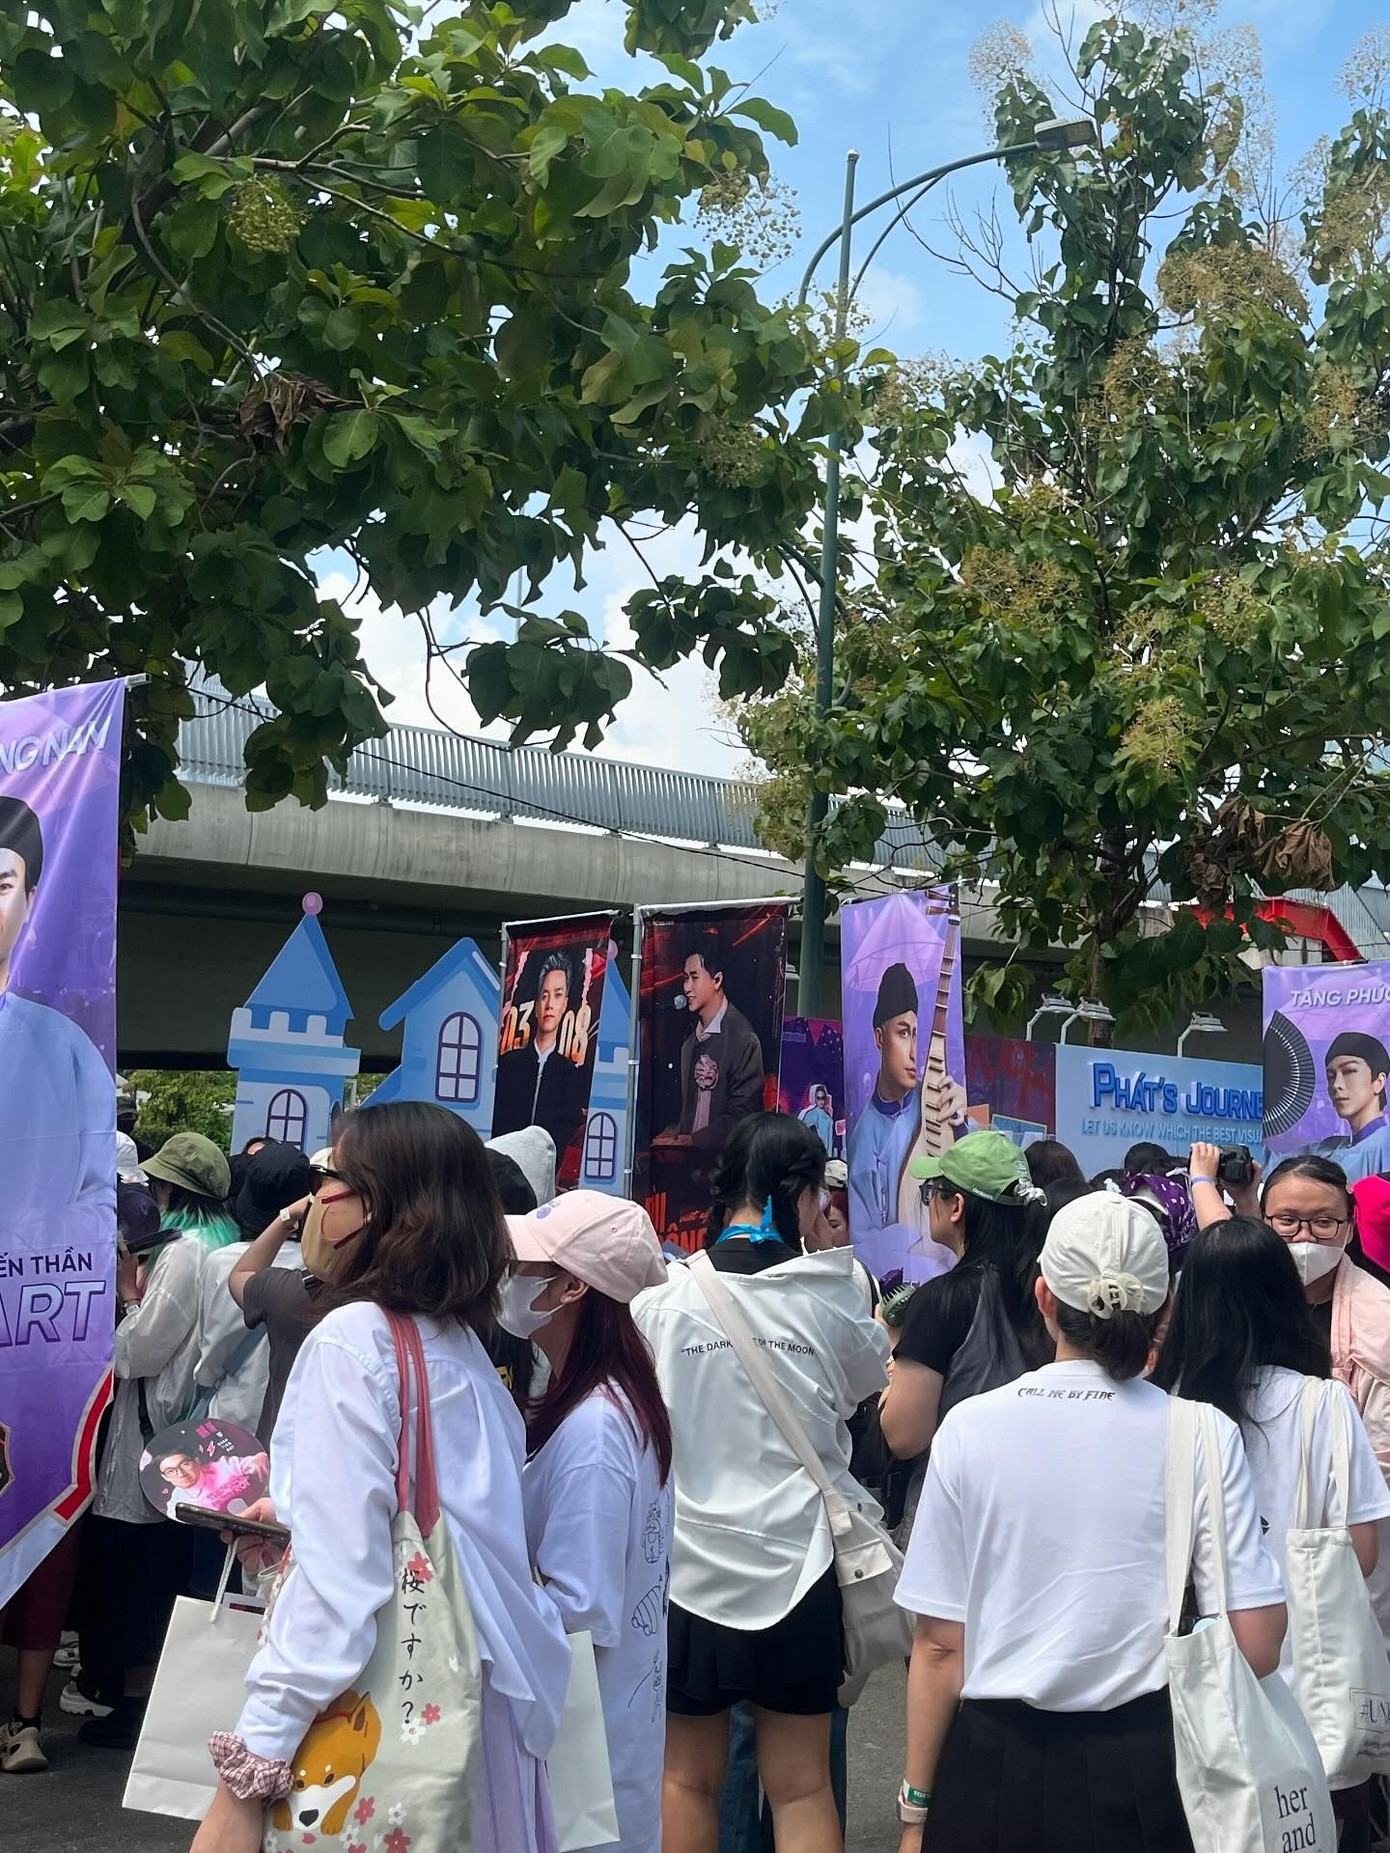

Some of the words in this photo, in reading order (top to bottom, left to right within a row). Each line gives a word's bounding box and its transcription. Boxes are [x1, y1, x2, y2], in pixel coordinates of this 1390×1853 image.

[1082, 1118, 1099, 1136] LET
[1103, 1119, 1117, 1136] US
[1119, 1120, 1154, 1138] KNOW
[1157, 1122, 1191, 1140] WHICH
[1193, 1125, 1211, 1142] THE
[1213, 1126, 1236, 1142] BEST
[31, 1246, 93, 1275] THẦN
[707, 1340, 733, 1352] DARK
[768, 1340, 785, 1350] THE
[788, 1344, 815, 1356] MOON
[1017, 1387, 1045, 1397] CALL
[1273, 1784, 1308, 1819] her
[1282, 1812, 1316, 1853] and
